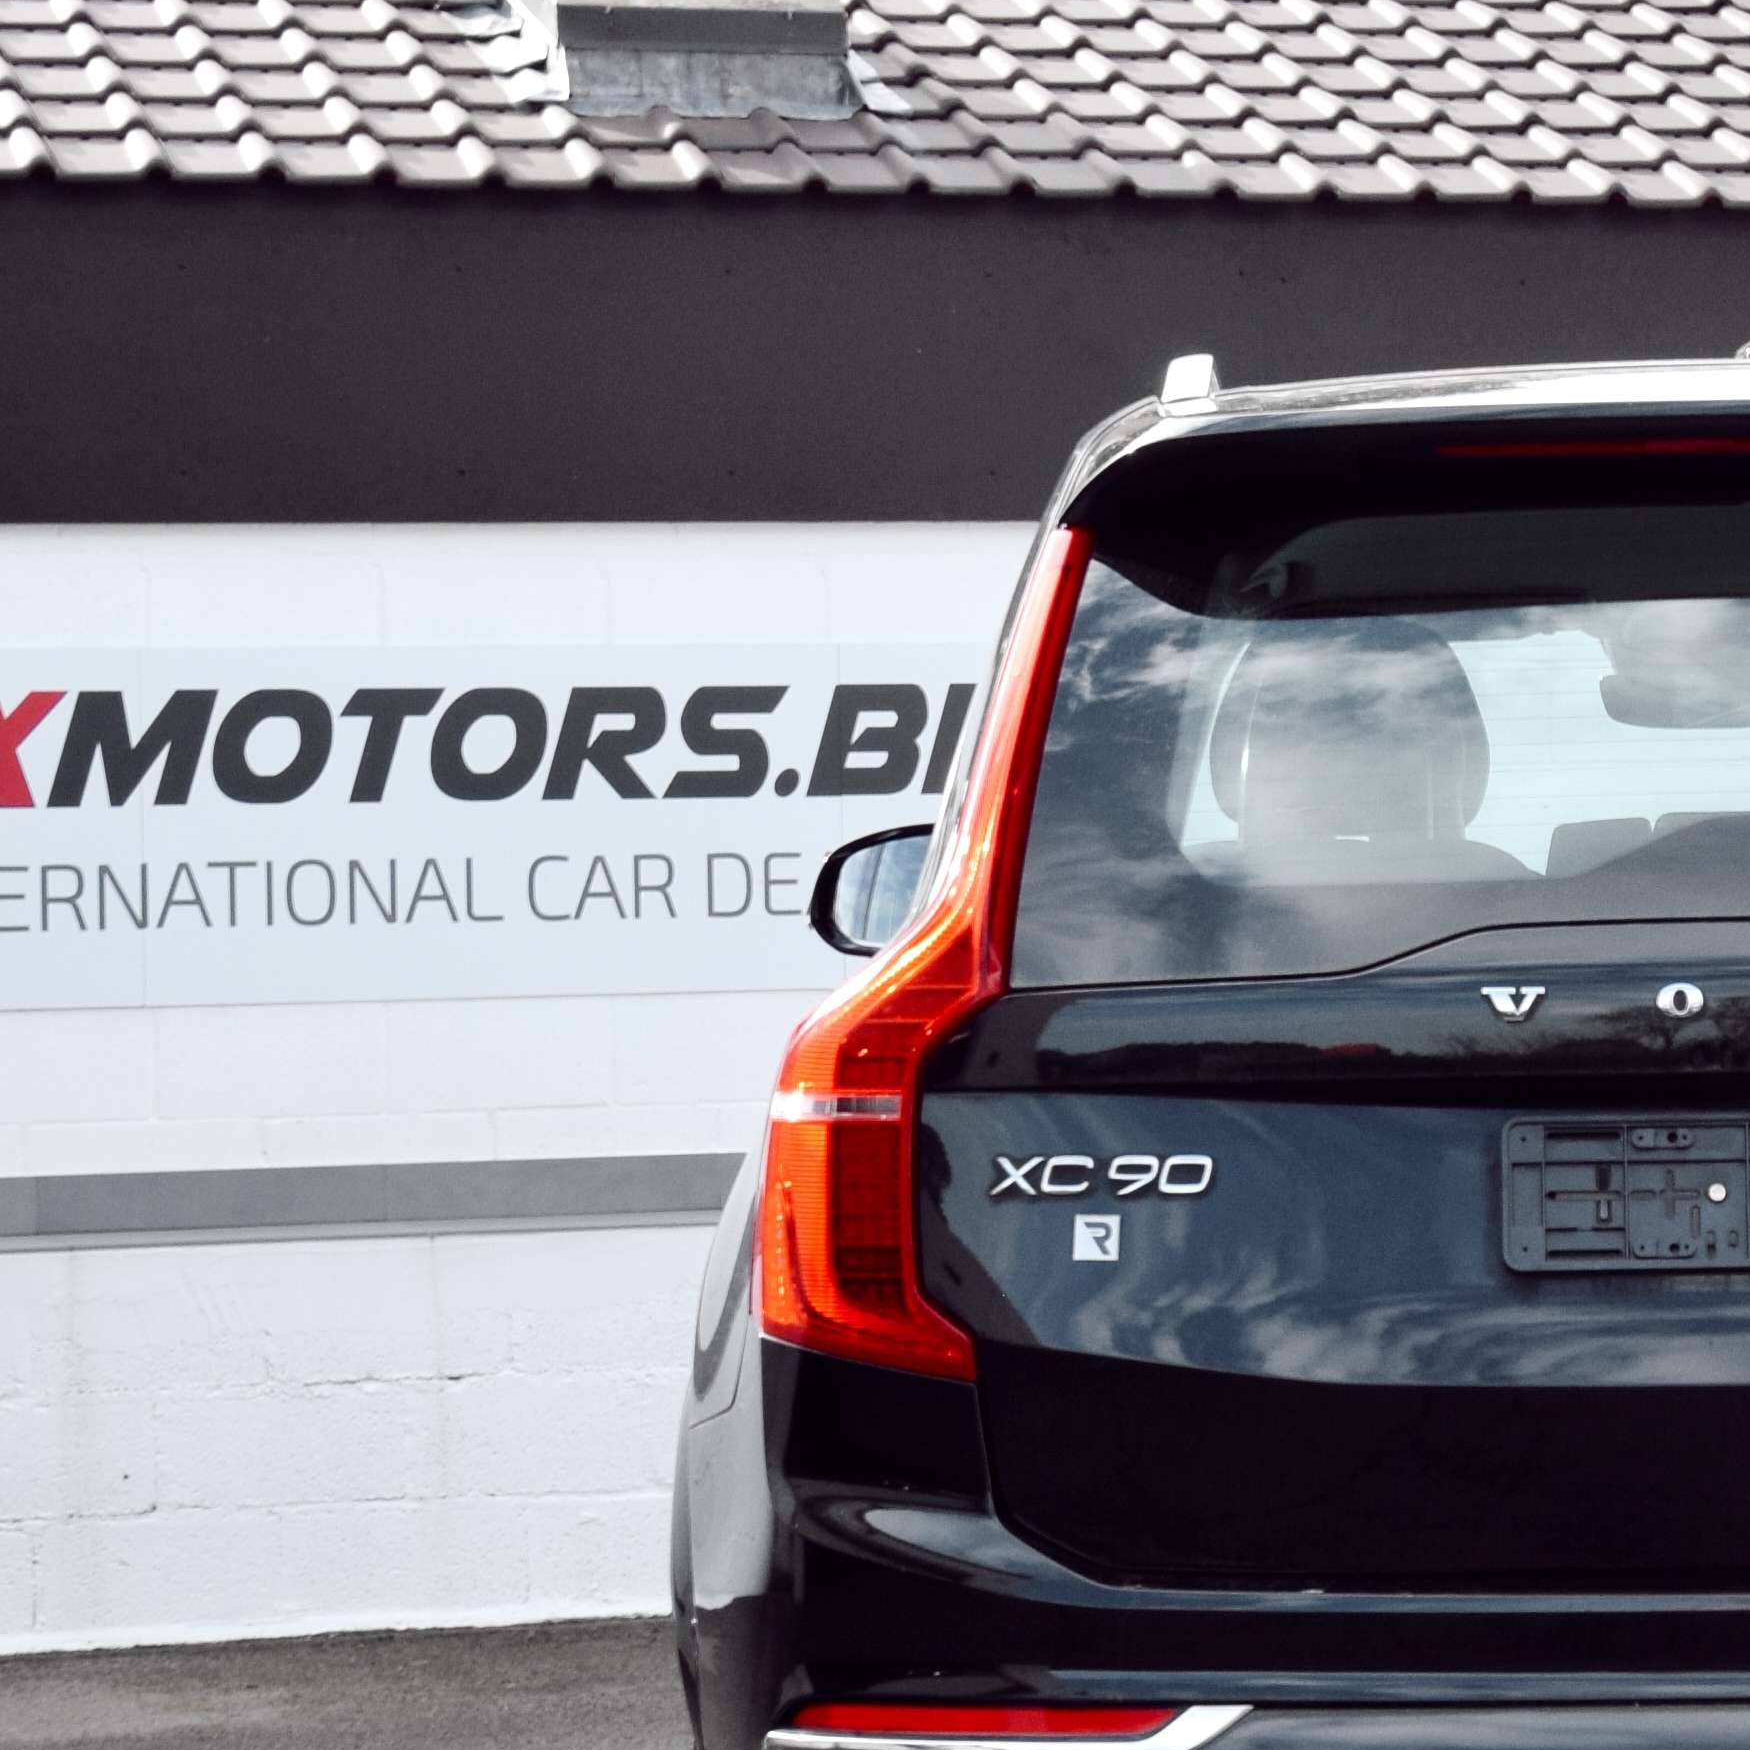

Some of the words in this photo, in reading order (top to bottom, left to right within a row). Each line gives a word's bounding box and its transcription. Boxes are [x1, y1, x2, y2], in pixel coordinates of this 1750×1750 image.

[0, 857, 503, 932] ERNATIONAL
[527, 853, 676, 921] CAR
[707, 852, 812, 917] DE
[1081, 1219, 1115, 1258] R
